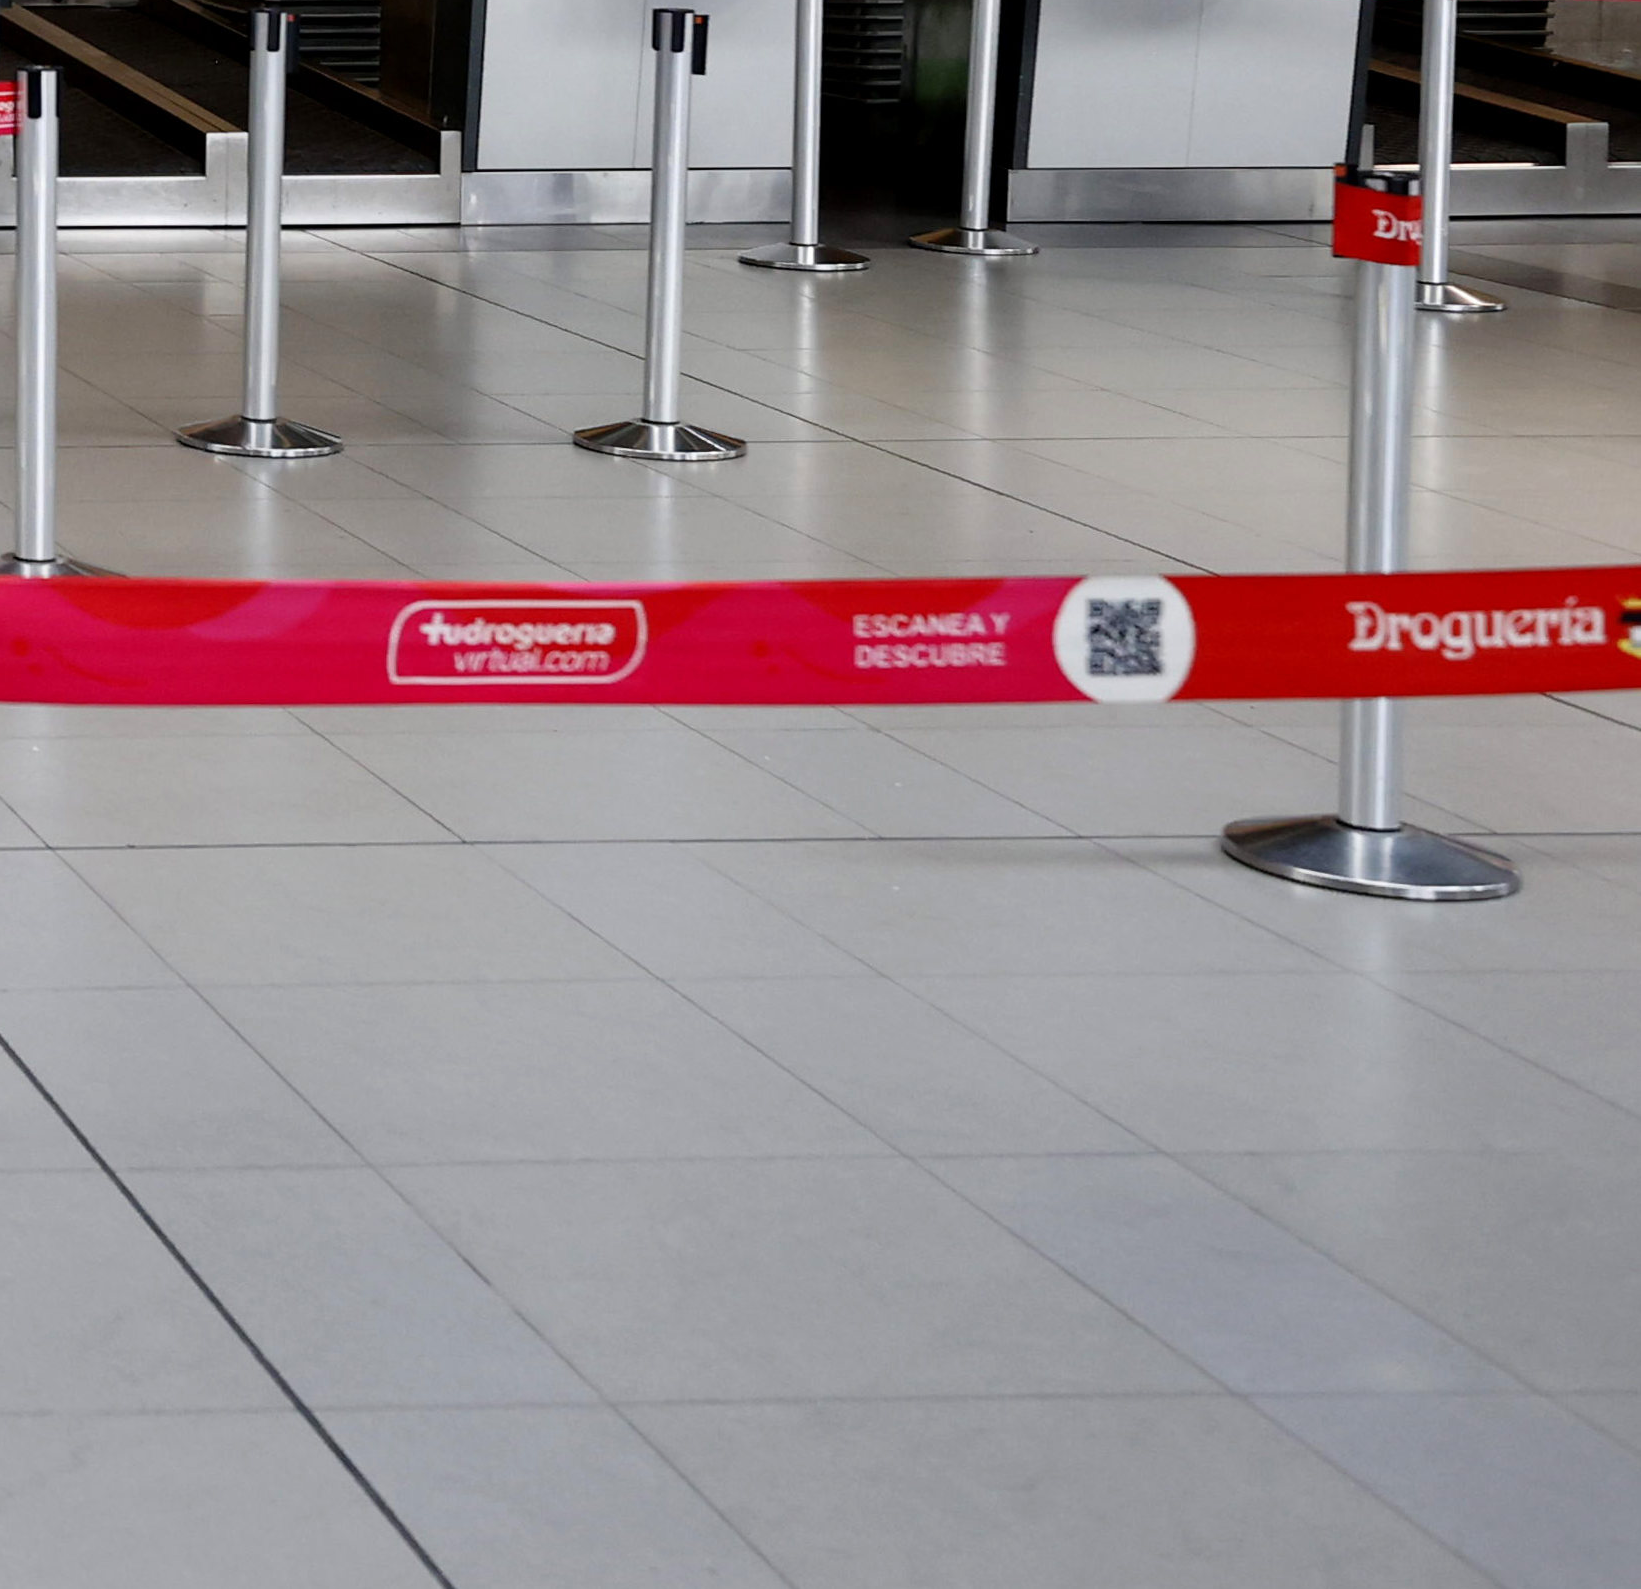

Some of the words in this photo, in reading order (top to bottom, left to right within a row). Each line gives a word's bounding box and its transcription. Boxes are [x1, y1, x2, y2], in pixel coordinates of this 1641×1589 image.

[852, 613, 984, 638] ESCANEA
[985, 613, 1011, 637] Y
[1344, 596, 1607, 662] Droguería
[453, 648, 611, 673] virtual.com
[853, 642, 1007, 669] DESCUBRE
